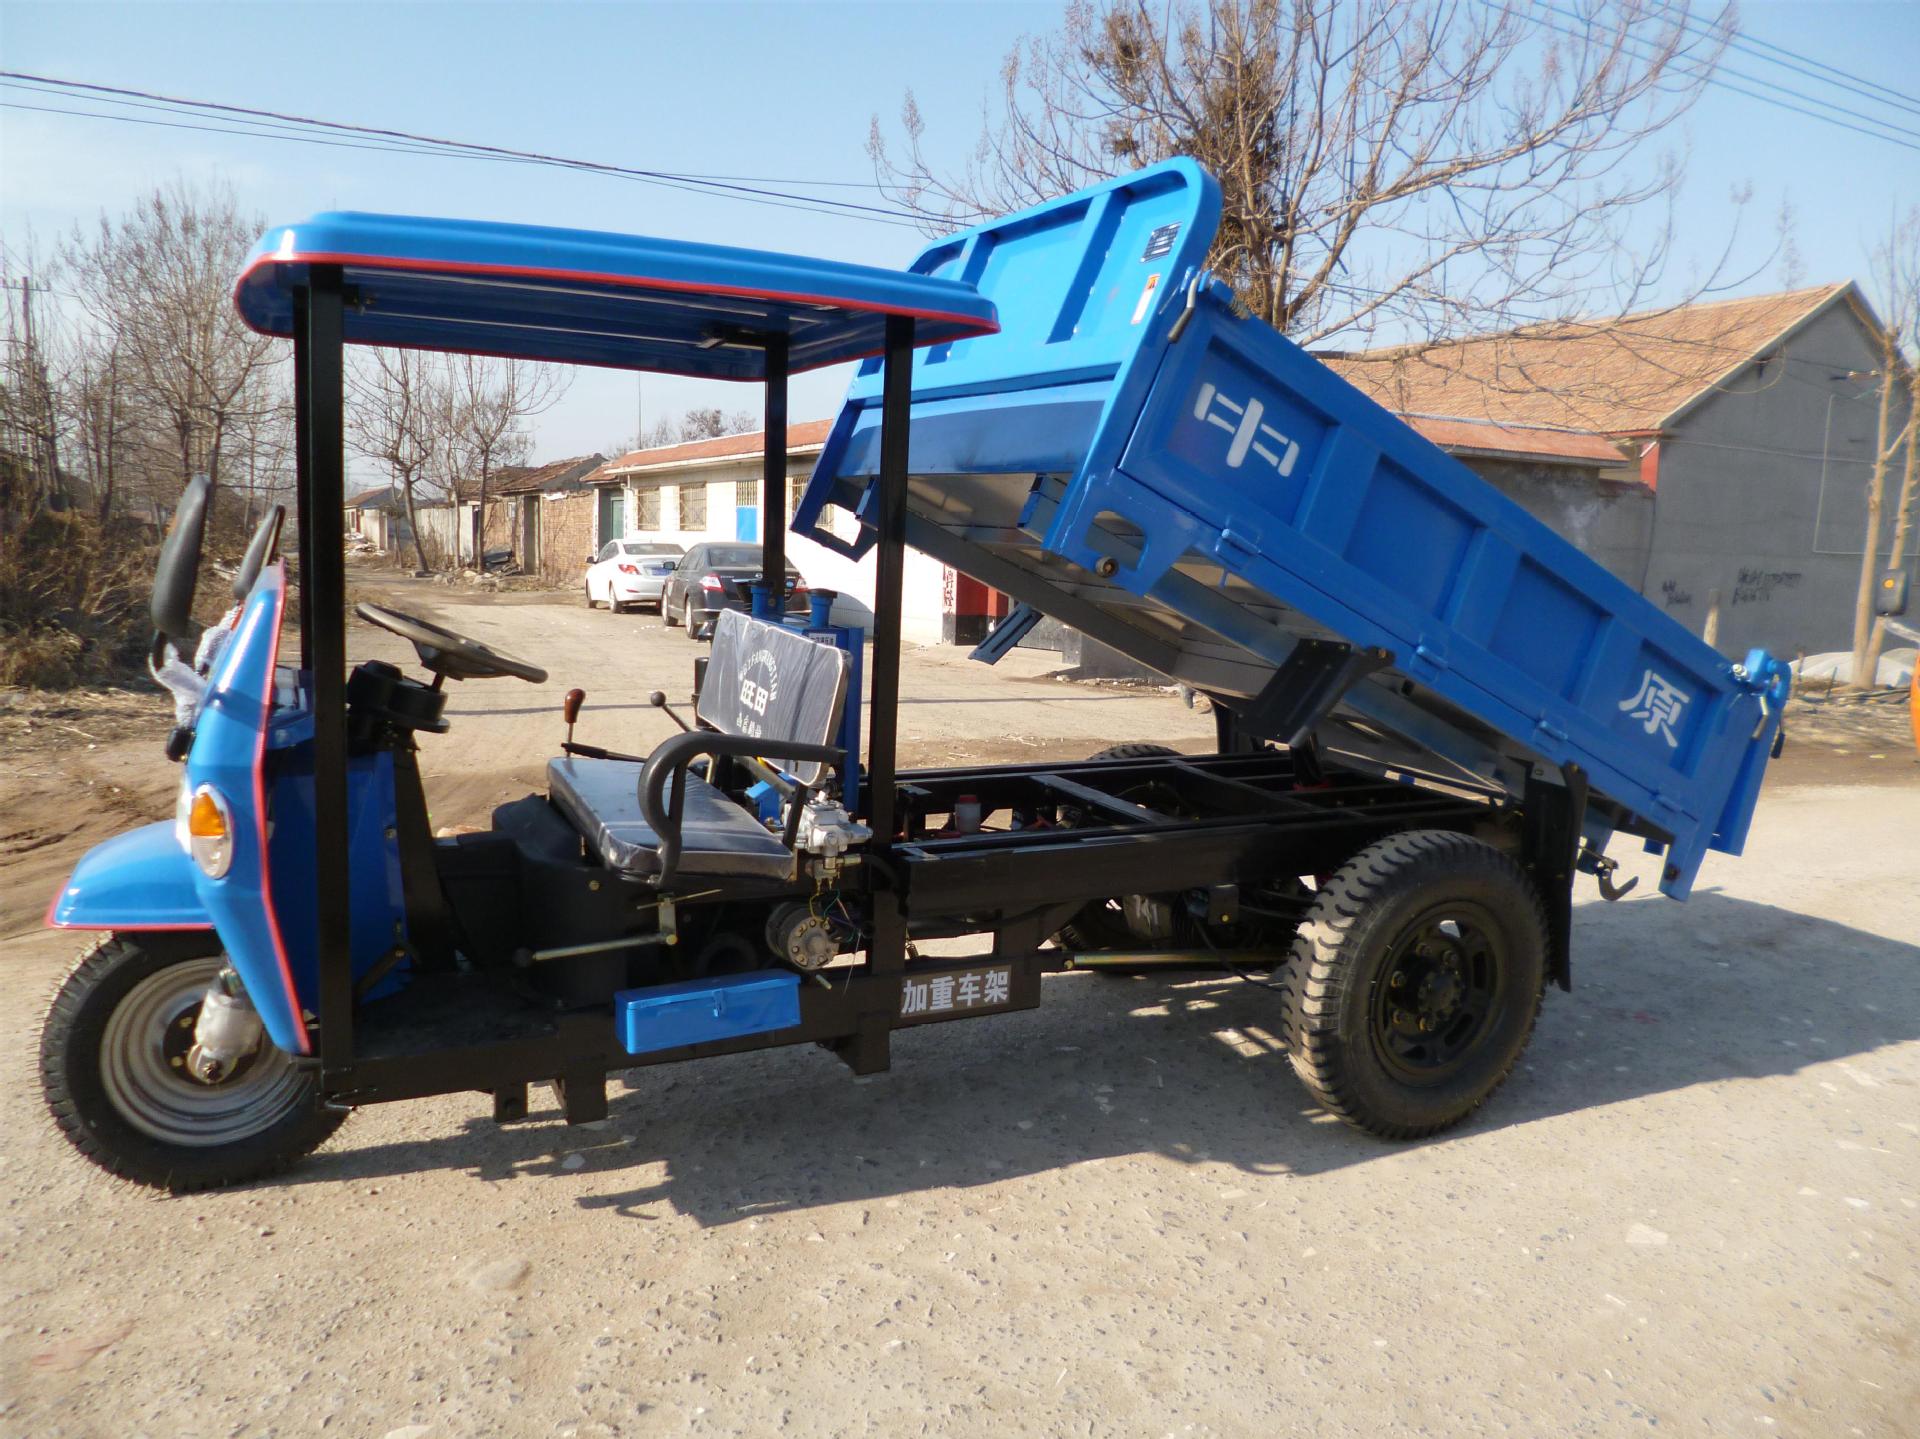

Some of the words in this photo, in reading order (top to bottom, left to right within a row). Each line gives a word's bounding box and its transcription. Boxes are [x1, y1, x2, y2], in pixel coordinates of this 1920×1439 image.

[1194, 383, 1299, 477] 中
[1618, 669, 1690, 748] 原
[901, 970, 1009, 1014] 加重车架
